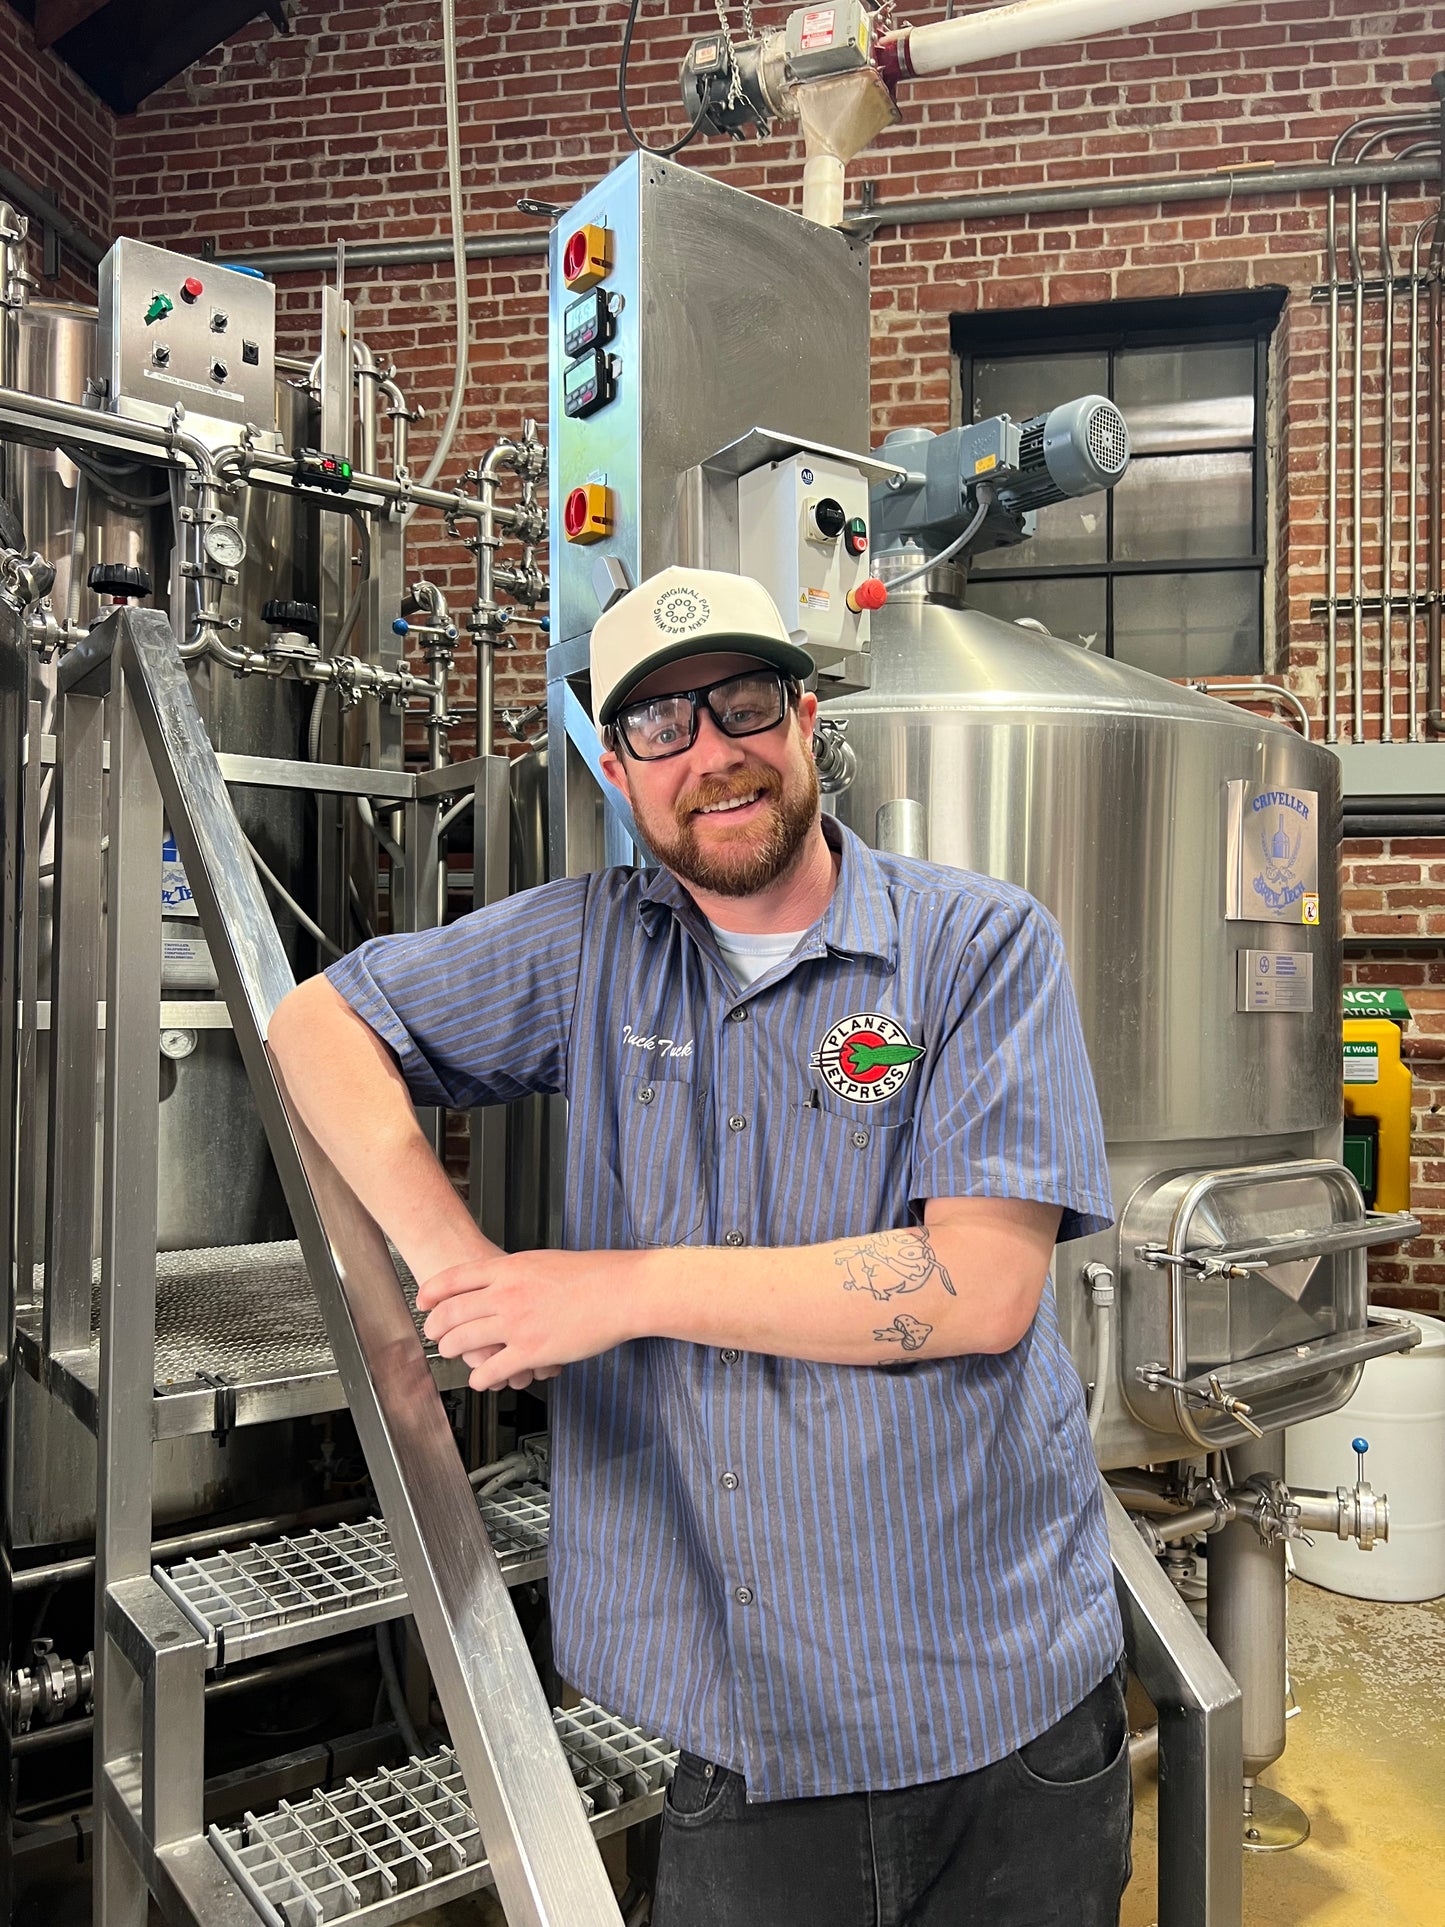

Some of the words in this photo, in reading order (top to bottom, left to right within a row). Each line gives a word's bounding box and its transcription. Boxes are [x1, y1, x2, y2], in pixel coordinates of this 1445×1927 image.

[656, 587, 699, 605] ORIGINAL
[653, 608, 685, 634] BREWING
[688, 598, 710, 631] PATTERN
[1252, 791, 1309, 820] CRIVELLER
[828, 1017, 900, 1047] PLANET
[658, 1039, 694, 1057] Tuck
[827, 1067, 904, 1099] EXPRESS
